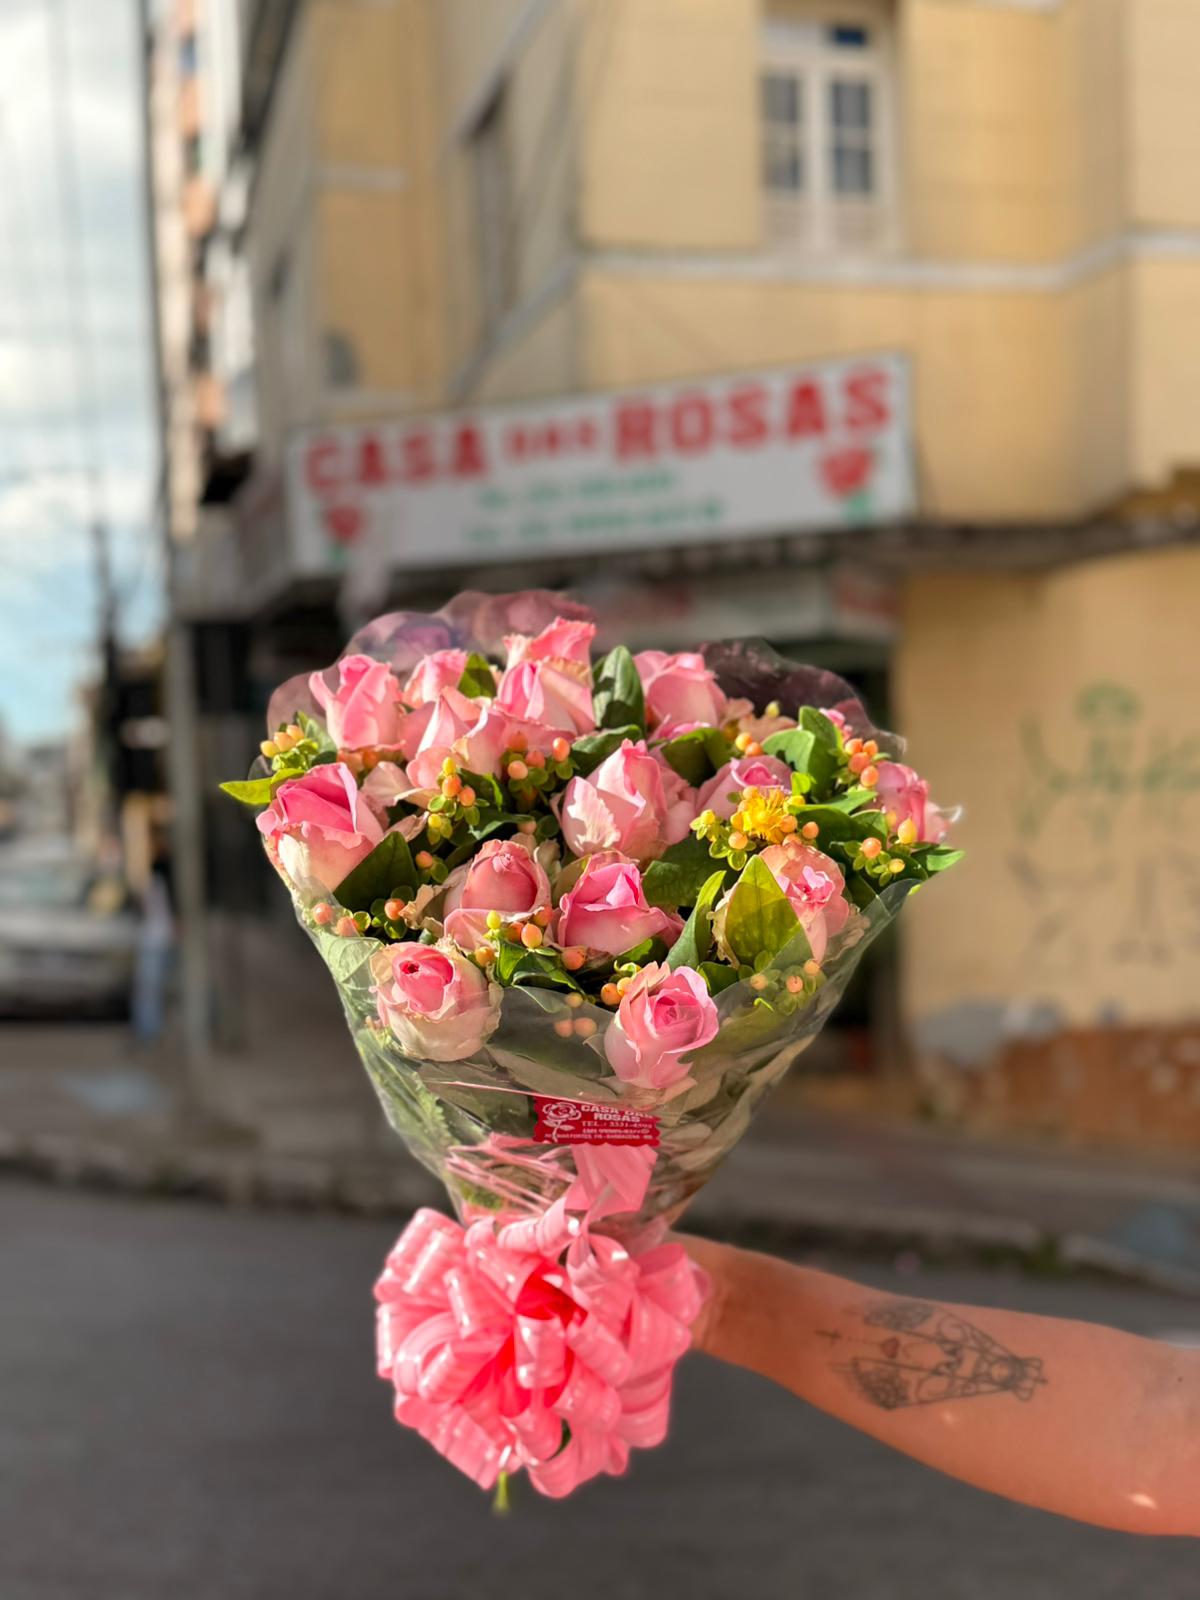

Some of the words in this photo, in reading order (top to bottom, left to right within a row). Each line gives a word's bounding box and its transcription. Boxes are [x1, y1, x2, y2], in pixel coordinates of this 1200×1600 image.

[303, 422, 487, 492] CASA
[613, 368, 892, 462] ROSAS
[581, 1104, 619, 1113] CASA
[594, 1113, 640, 1122] ROSAS
